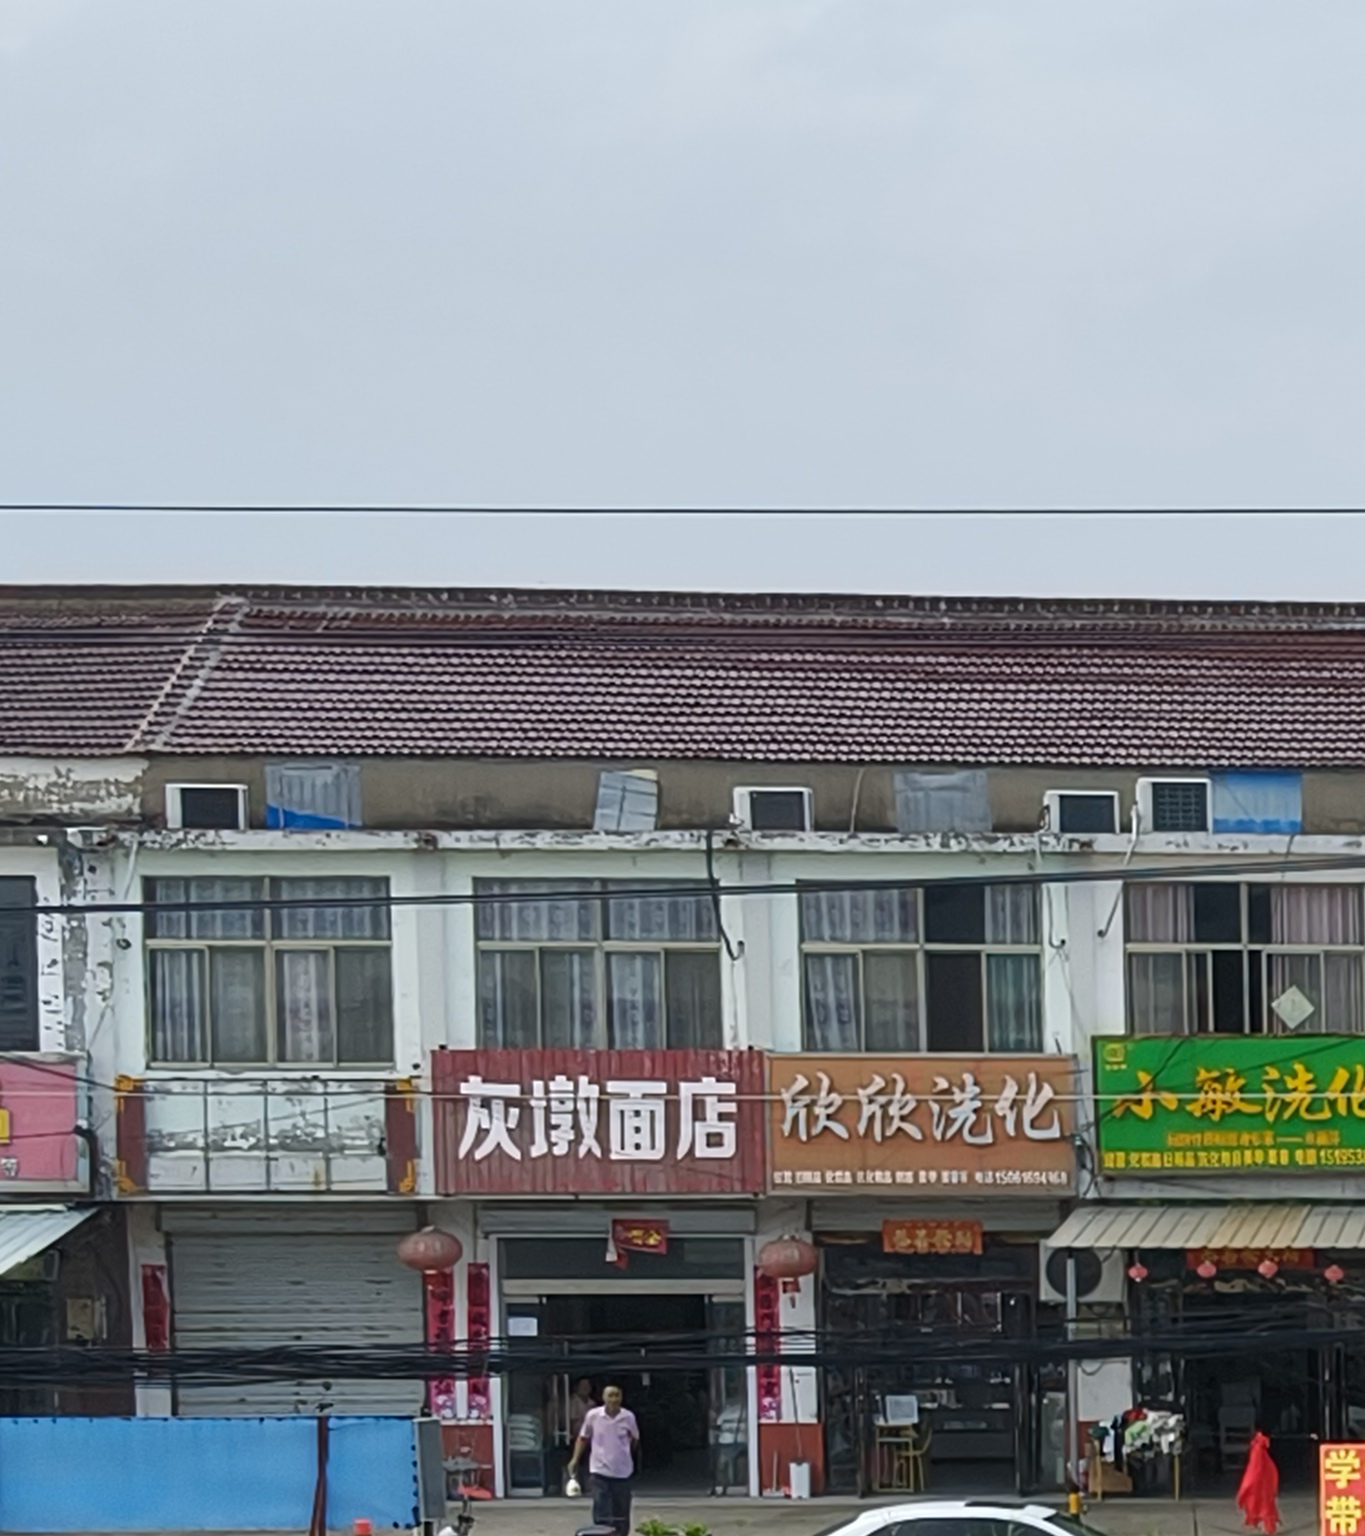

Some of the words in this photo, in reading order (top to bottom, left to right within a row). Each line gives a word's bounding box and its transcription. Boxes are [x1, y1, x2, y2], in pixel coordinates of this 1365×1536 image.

[458, 1075, 737, 1161] 灰墩面店
[779, 1072, 1061, 1146] 欣欣洗化
